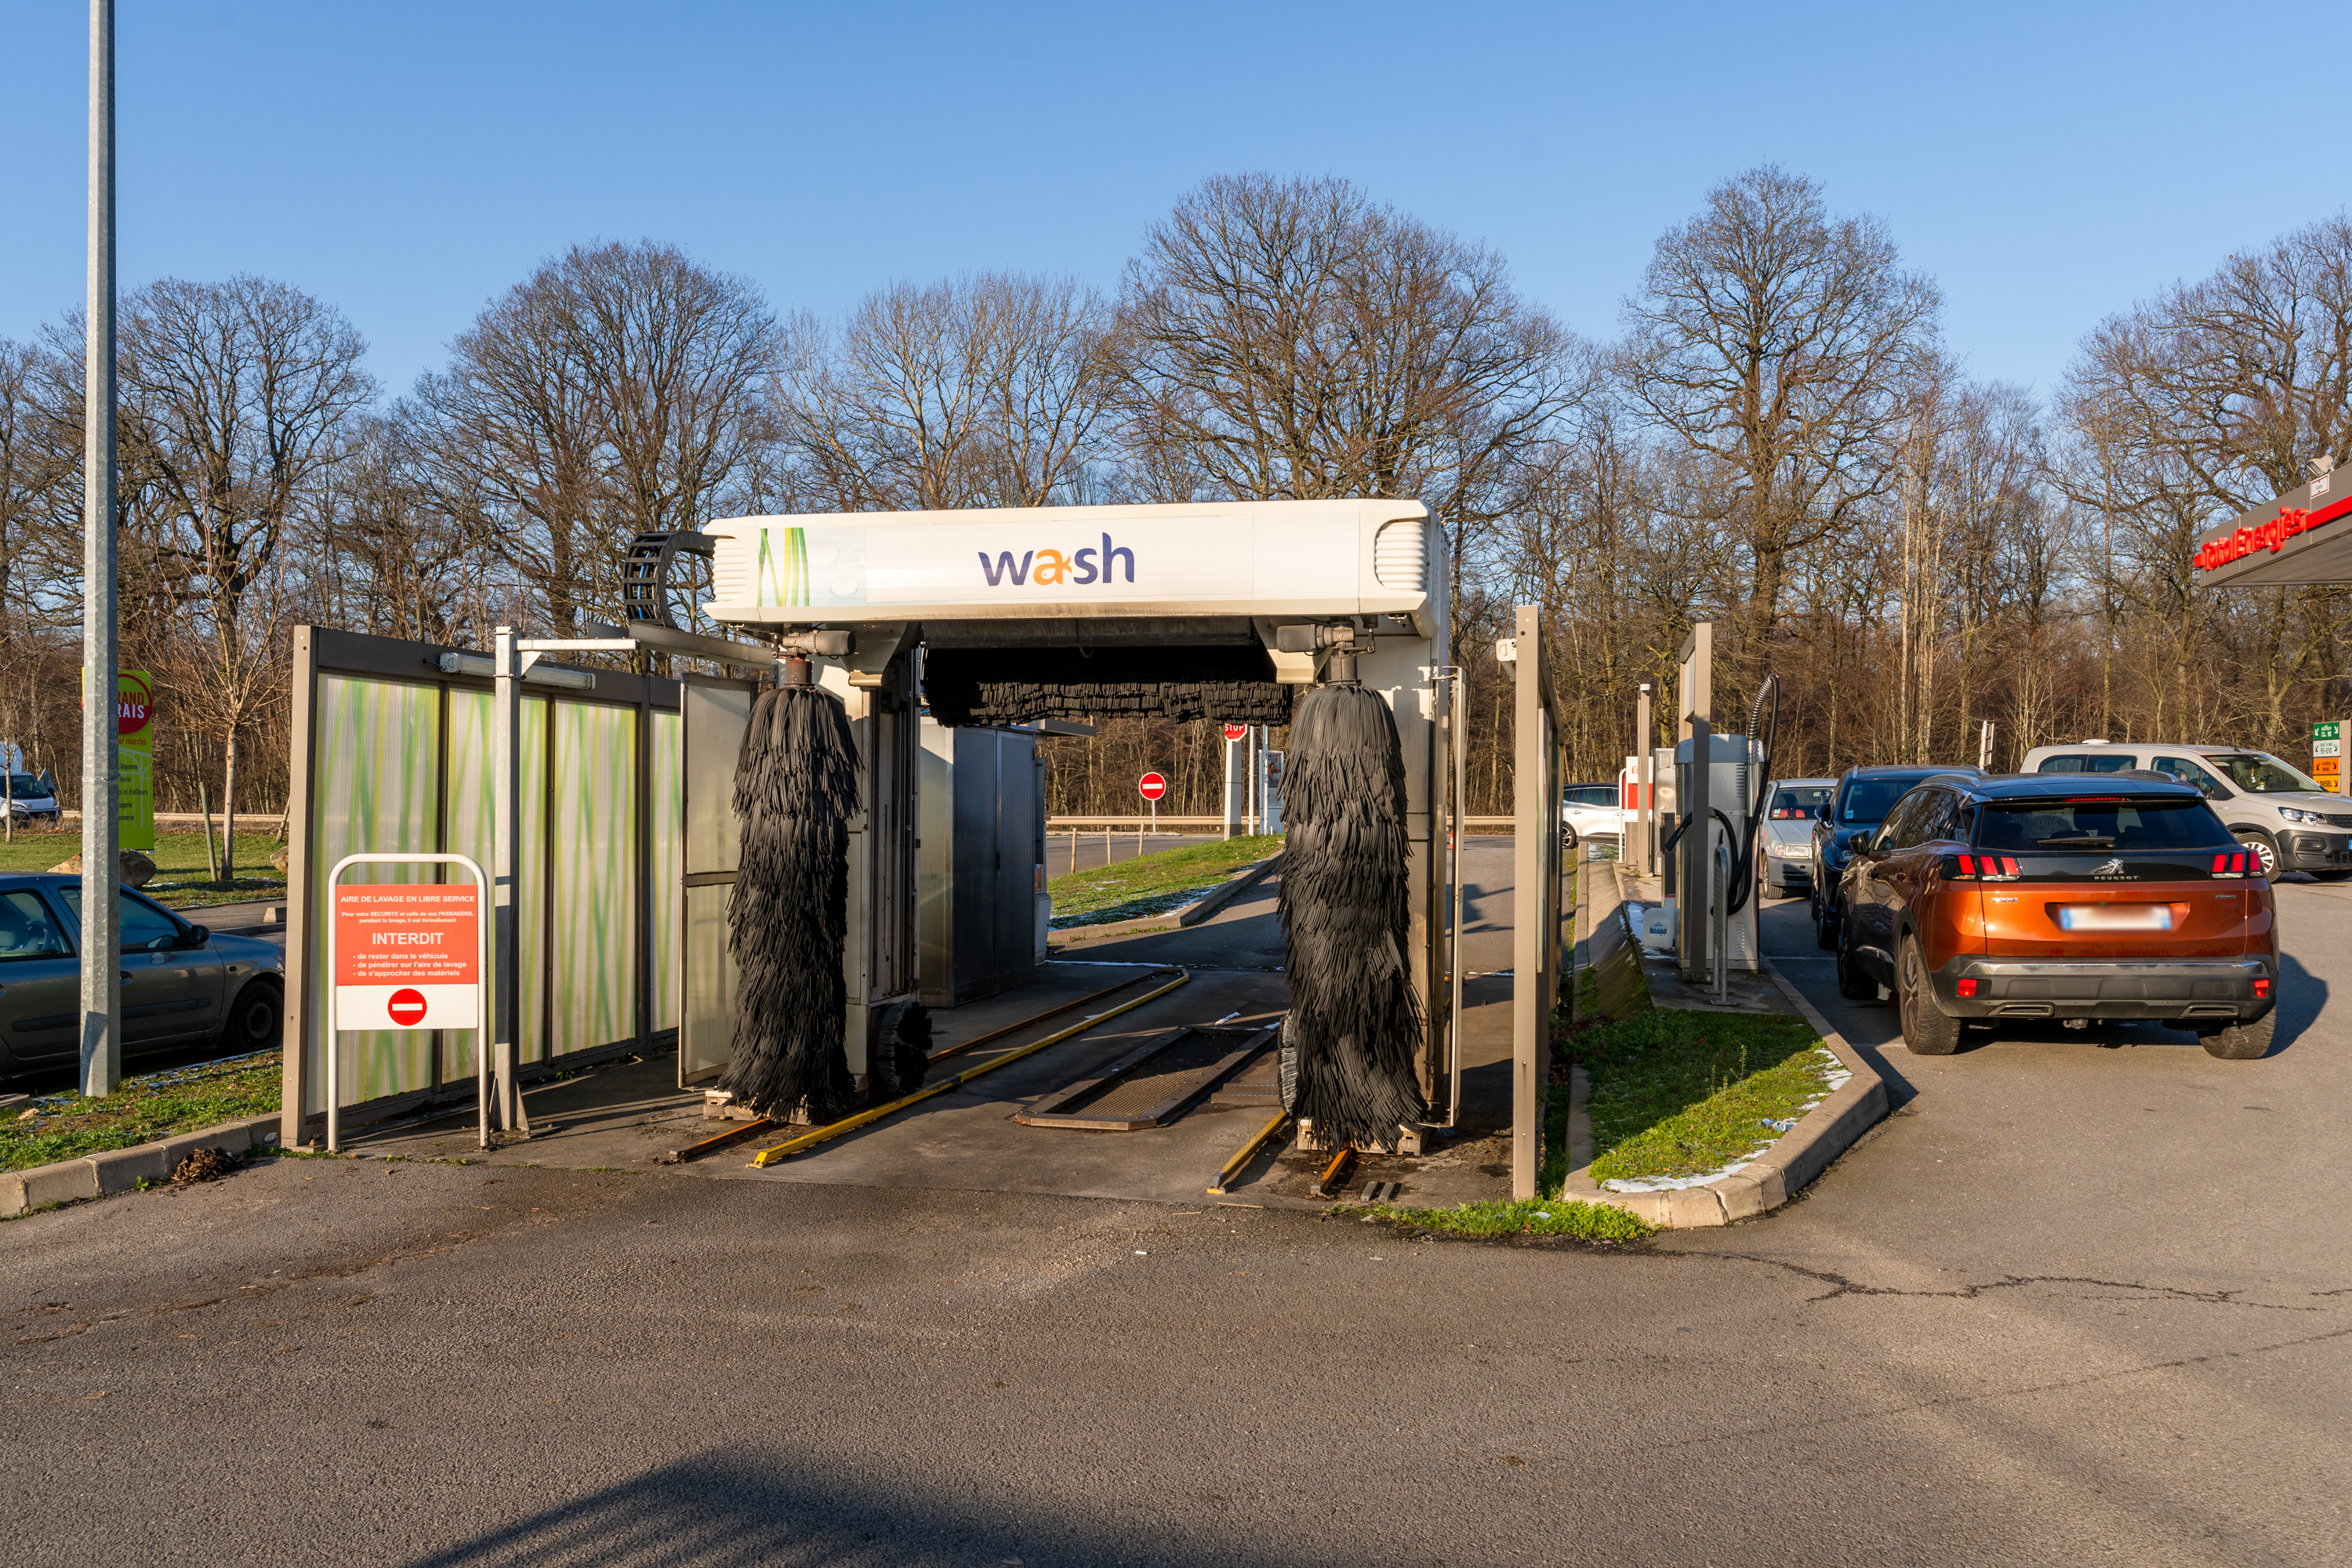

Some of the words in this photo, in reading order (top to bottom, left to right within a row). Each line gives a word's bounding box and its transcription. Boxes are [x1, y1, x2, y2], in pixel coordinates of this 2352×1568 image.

[978, 532, 1135, 586] wash
[118, 691, 144, 706] RAND
[118, 703, 144, 719] RAIS
[372, 932, 445, 946] INTERDIT
